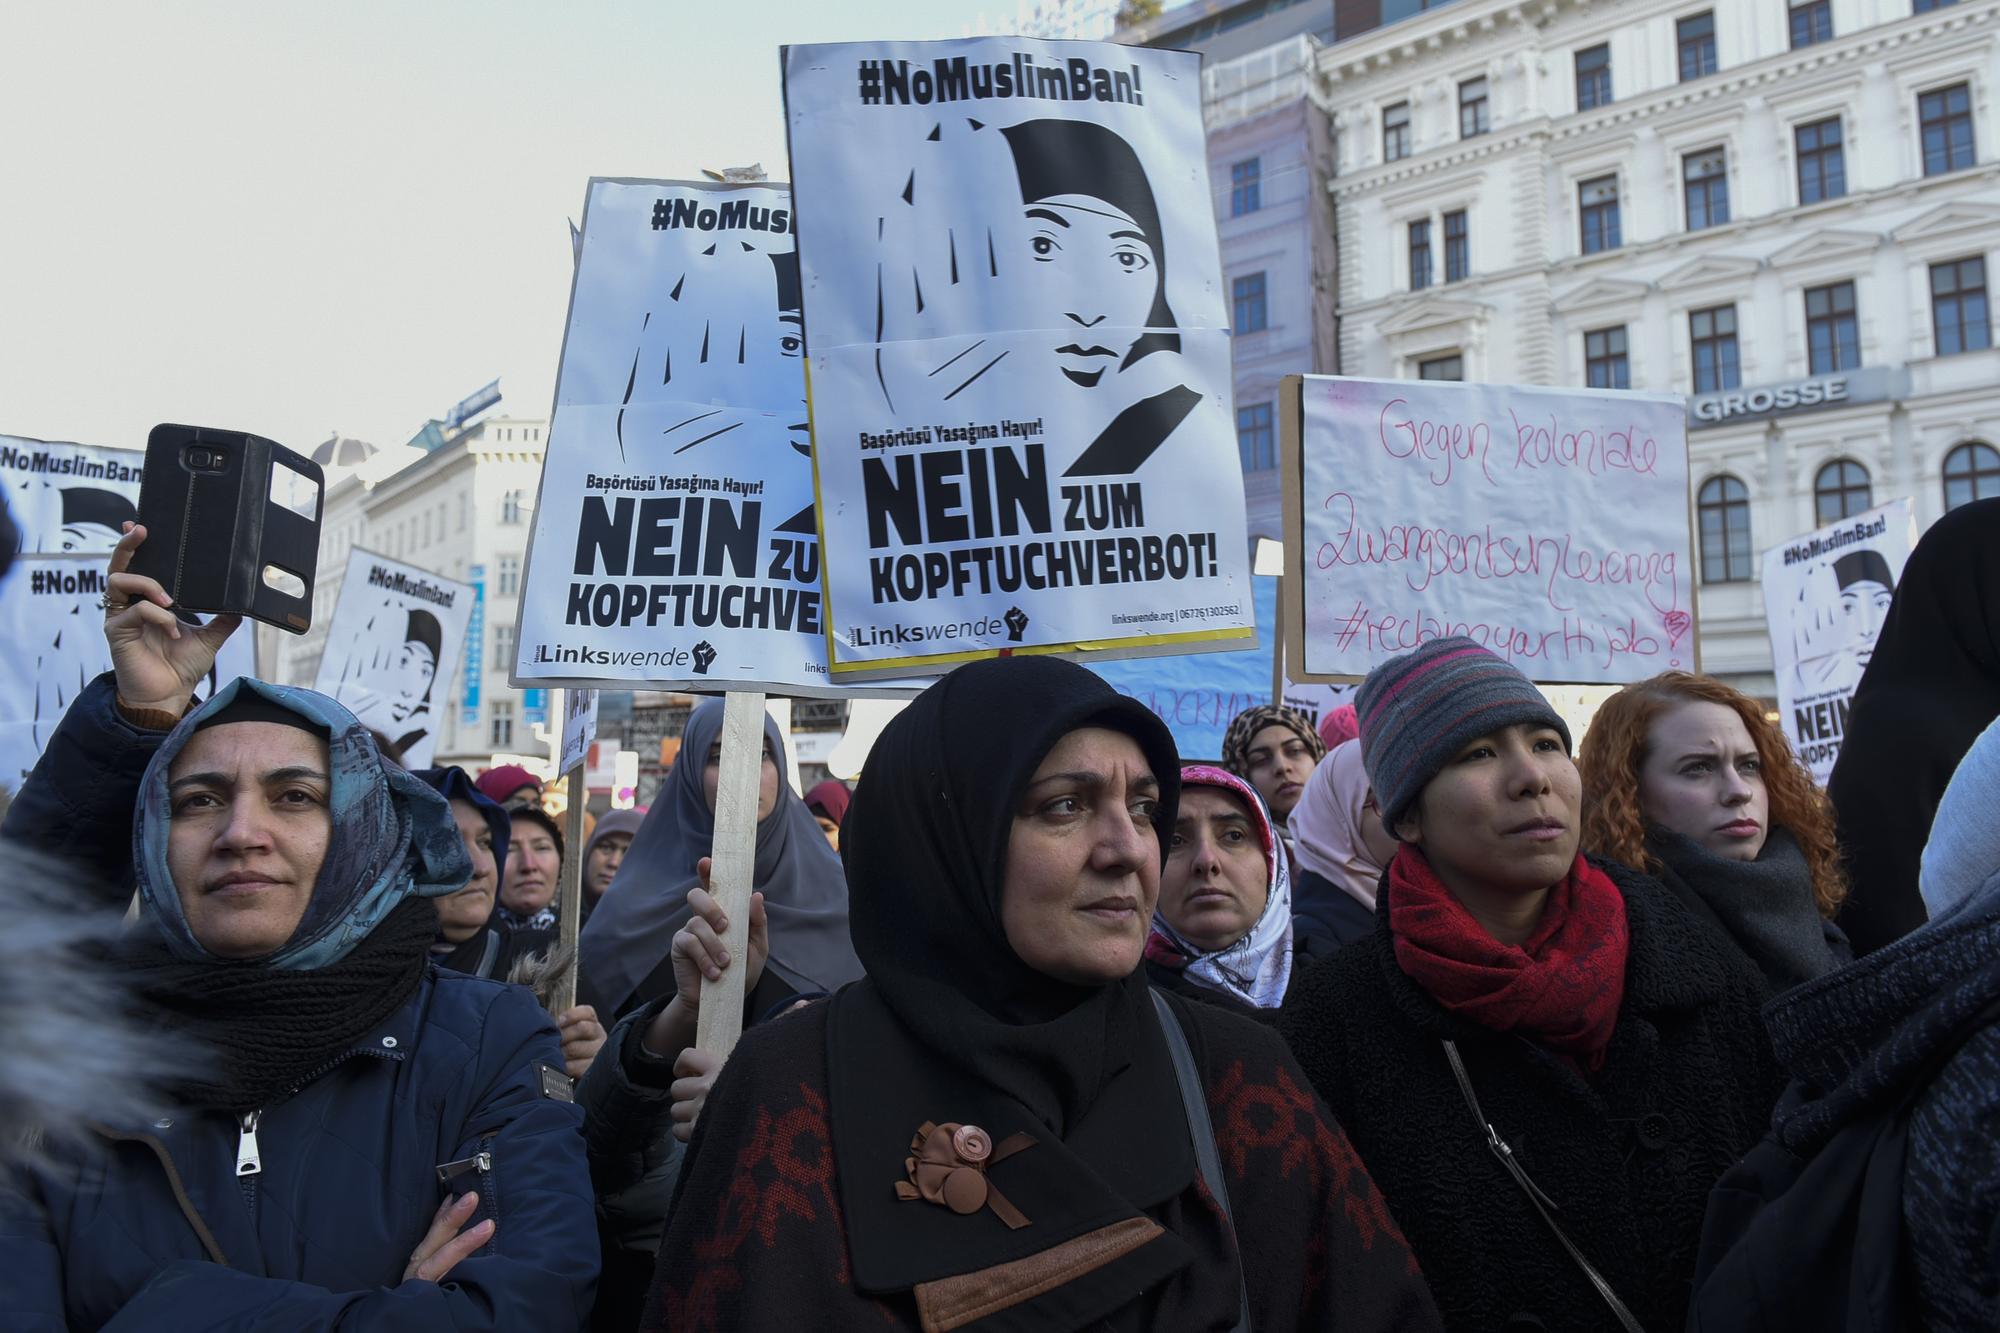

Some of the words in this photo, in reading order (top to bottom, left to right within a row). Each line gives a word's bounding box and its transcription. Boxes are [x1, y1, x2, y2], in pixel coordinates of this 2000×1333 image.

[858, 52, 1144, 106] #NoMuslimBan!
[1693, 376, 1849, 422] GROSSE
[0, 447, 142, 483] NoMuslimBan
[1379, 399, 1498, 486] Gegen
[586, 474, 656, 494] Başörtüsü
[660, 474, 720, 493] Yasağına
[723, 477, 764, 497] Hayır!
[861, 443, 1052, 549] NEIN
[1060, 482, 1144, 531] ZUM
[573, 495, 762, 579] NEIN
[768, 538, 822, 584] ZU
[870, 532, 1218, 604] KOPFTUCHVERBOT!
[565, 582, 824, 635] KOPFTUCHVE
[856, 616, 1002, 647] Linkswende
[540, 644, 689, 667] Linkswende
[804, 662, 827, 674] links
